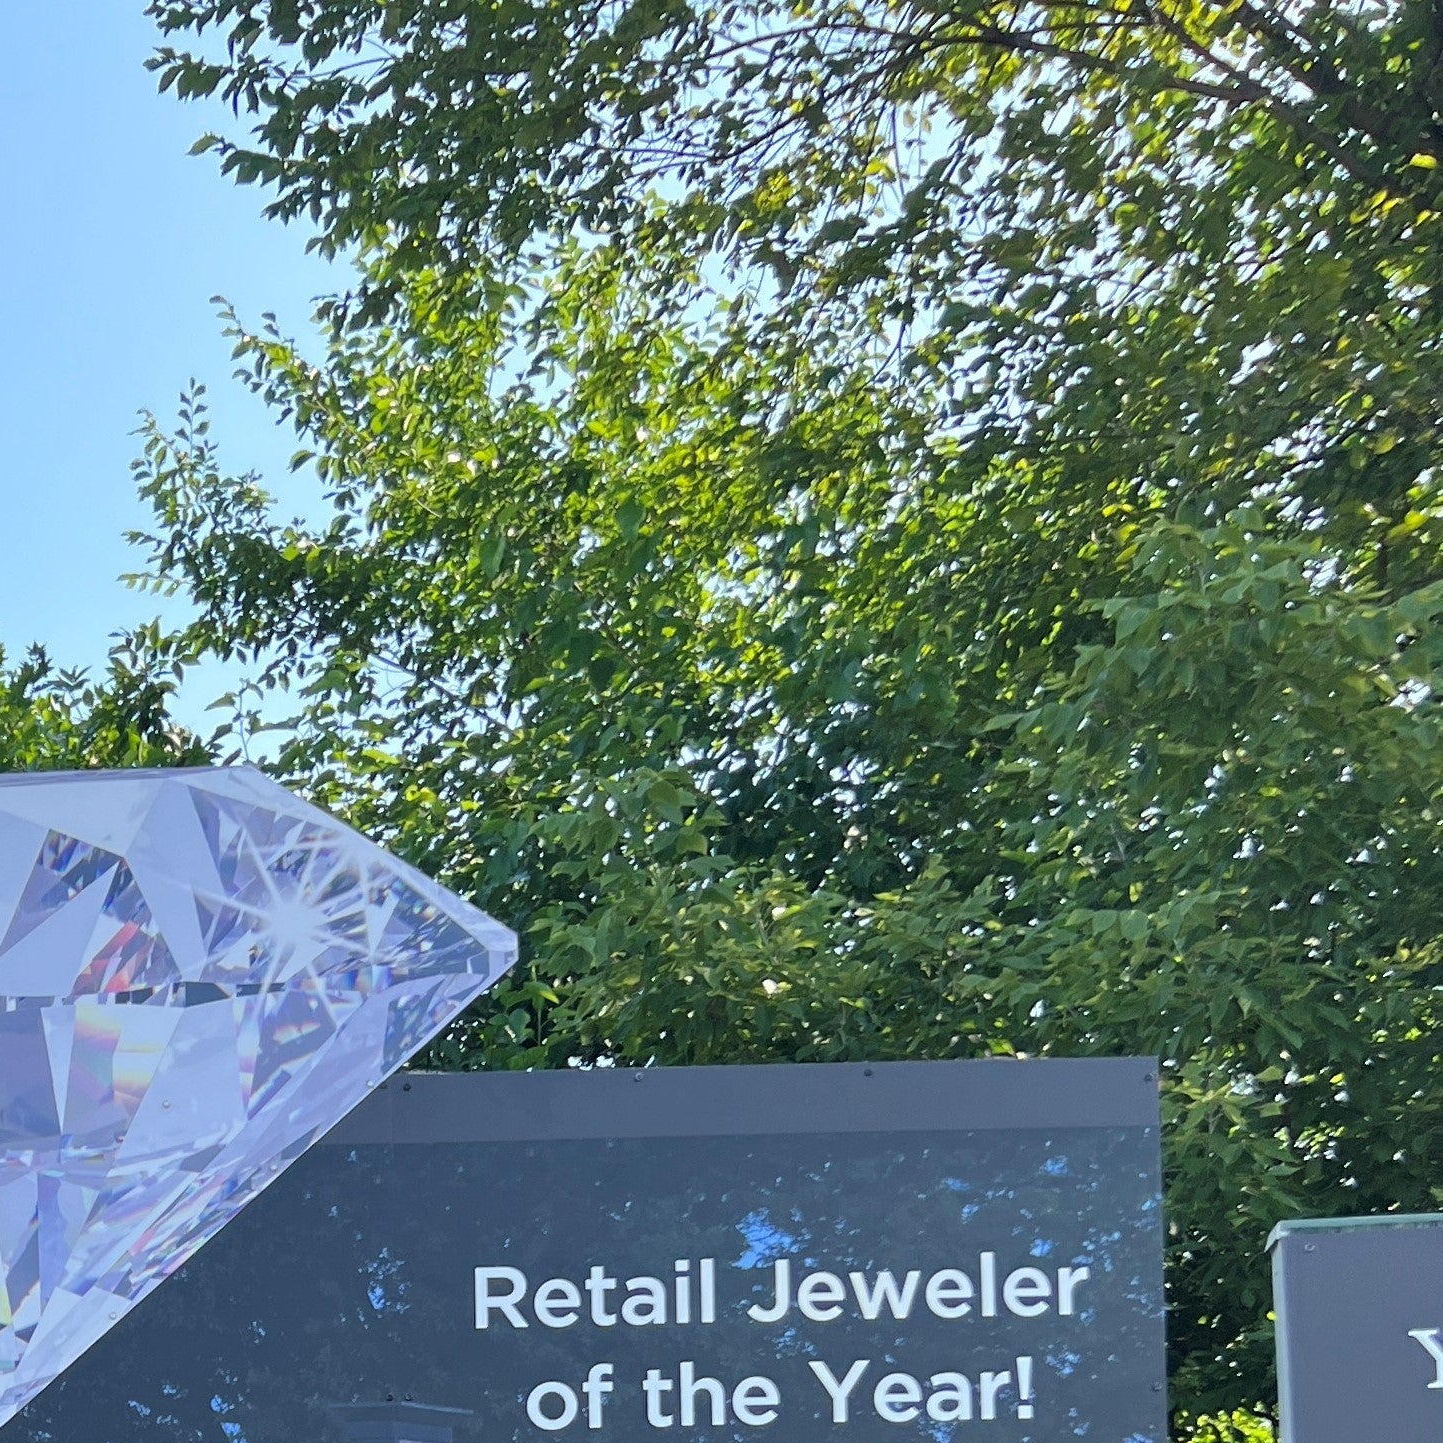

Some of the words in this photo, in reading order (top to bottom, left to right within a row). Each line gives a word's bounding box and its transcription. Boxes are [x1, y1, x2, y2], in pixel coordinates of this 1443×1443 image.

[474, 1258, 716, 1330] Retail
[747, 1251, 1090, 1324] Jeweler
[526, 1363, 614, 1431] of
[642, 1361, 781, 1428] the
[808, 1355, 1034, 1424] Year!
